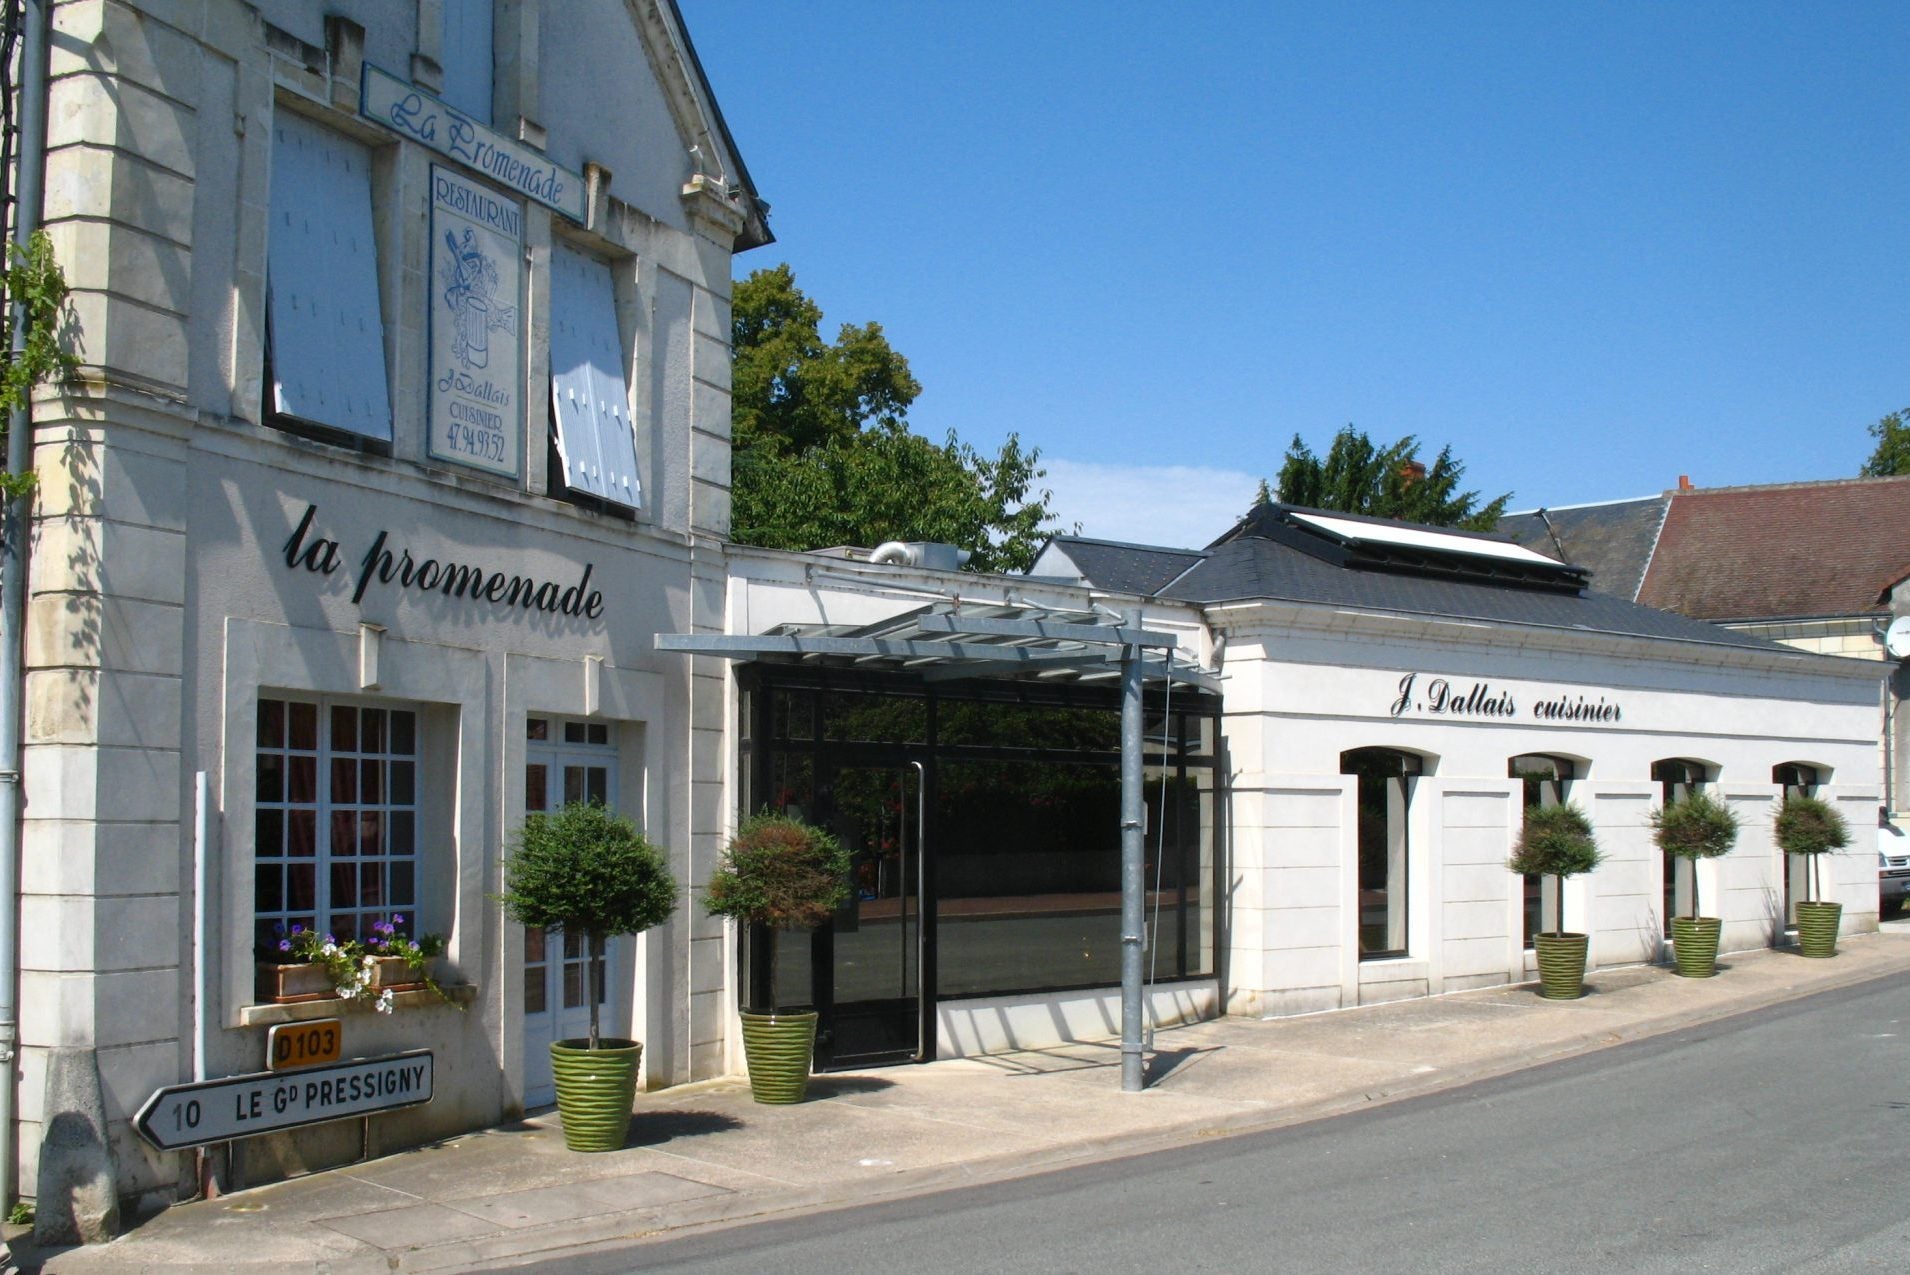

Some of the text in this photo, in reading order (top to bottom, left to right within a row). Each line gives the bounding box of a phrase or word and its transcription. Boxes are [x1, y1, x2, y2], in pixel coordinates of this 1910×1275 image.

[390, 93, 565, 205] La Promenade
[436, 176, 519, 235] RESTAURANT
[449, 401, 503, 433] CUISINIER
[282, 503, 604, 619] la promenade
[1390, 672, 1622, 723] J. Dallais cuisinier
[171, 1100, 200, 1132] 10
[235, 1091, 262, 1121] LE
[305, 1066, 424, 1109] PRESSIGNY
